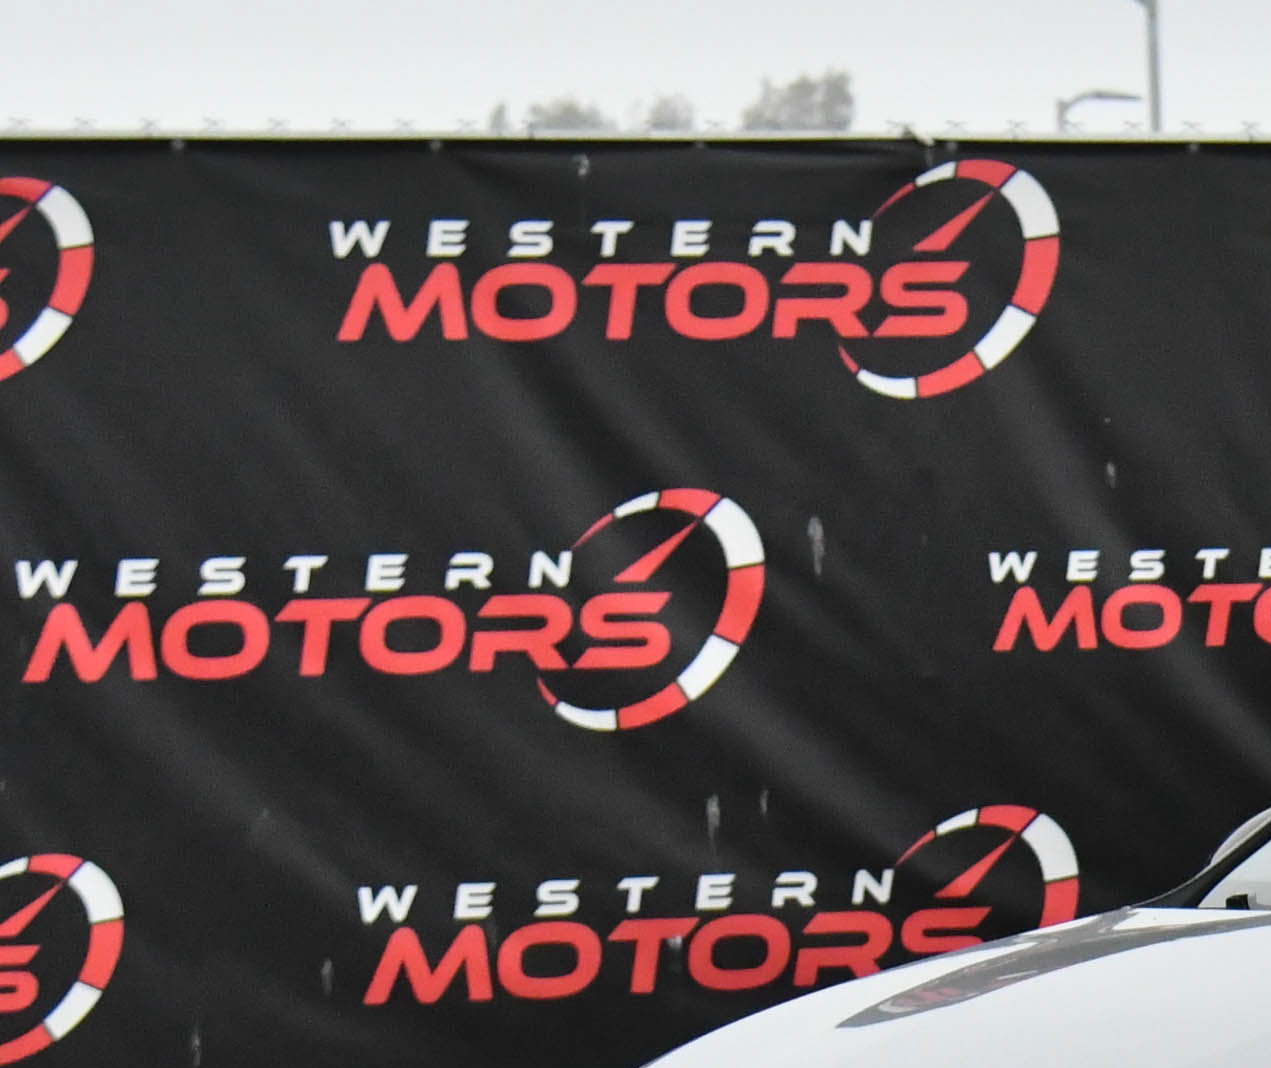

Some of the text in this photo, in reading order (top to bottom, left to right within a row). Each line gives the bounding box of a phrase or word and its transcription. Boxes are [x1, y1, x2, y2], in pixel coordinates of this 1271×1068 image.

[329, 219, 873, 259] WESTERN
[337, 261, 971, 343] MOTORS
[15, 551, 573, 599] WESTERN
[22, 591, 671, 683] MOTORS
[357, 868, 895, 924] WESTERN
[363, 906, 991, 1006] MOTORS
